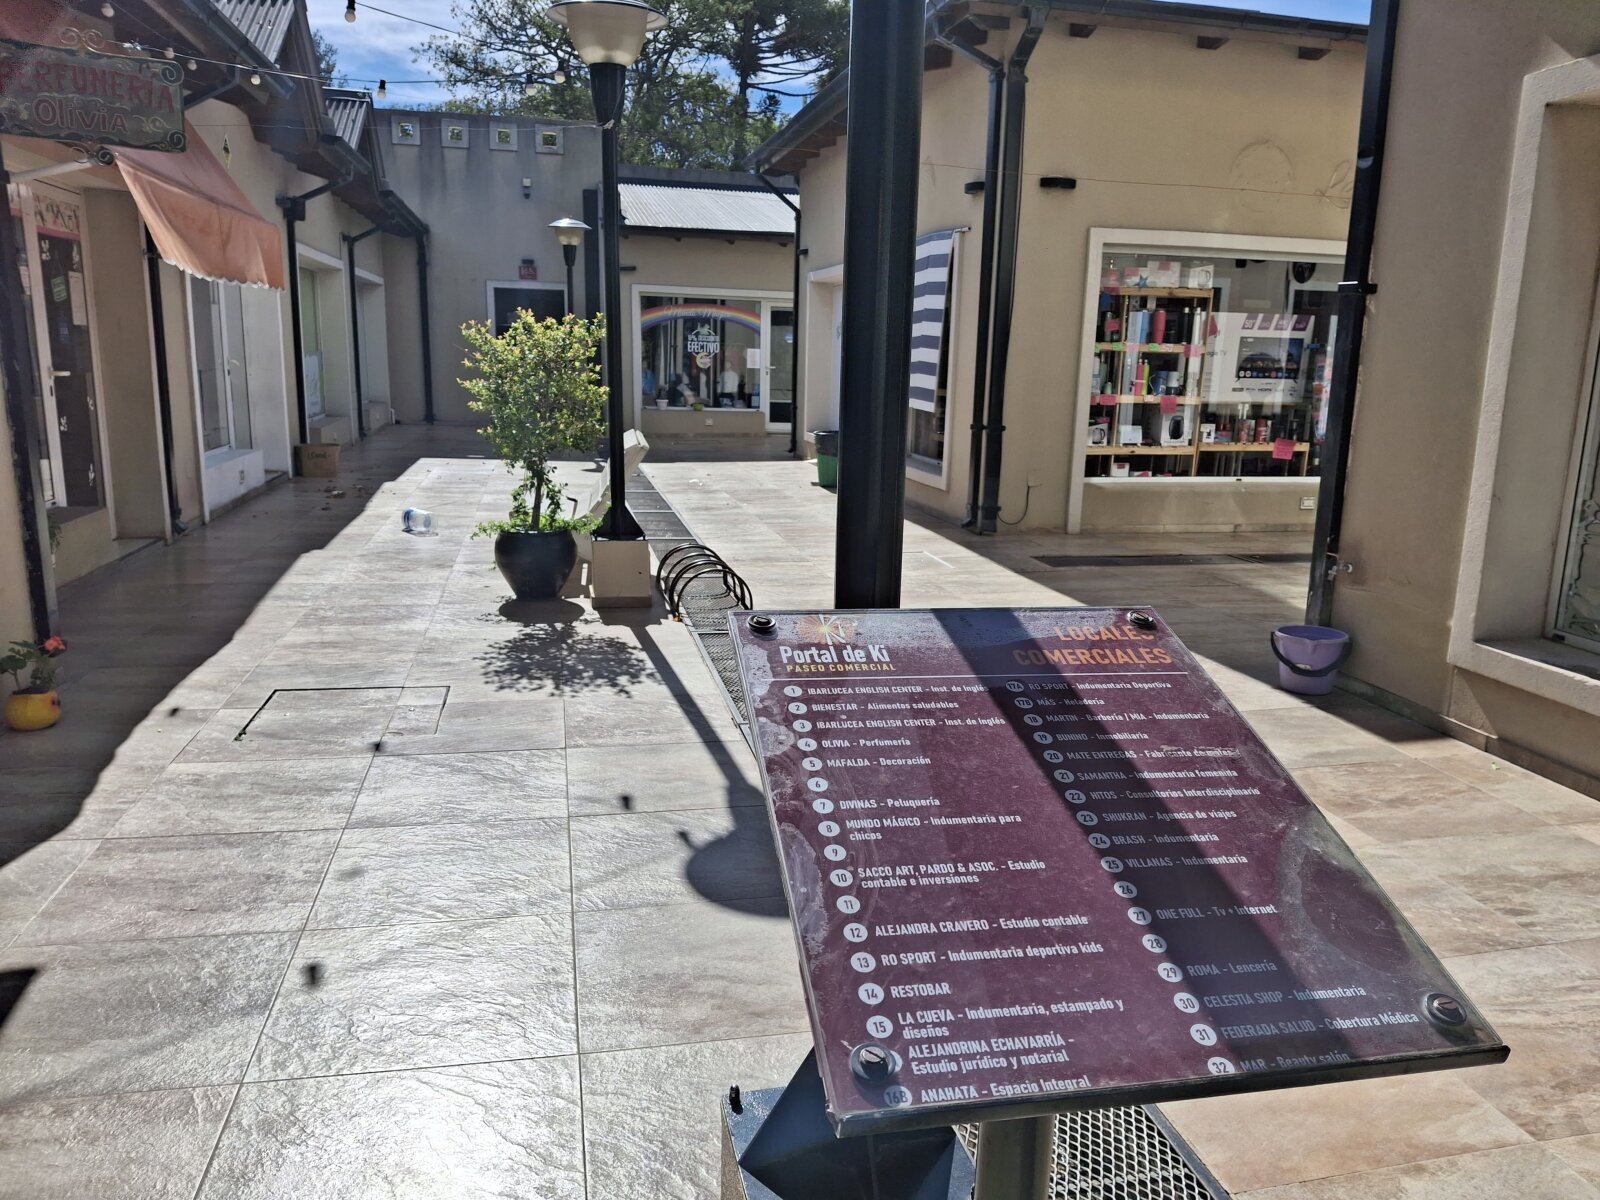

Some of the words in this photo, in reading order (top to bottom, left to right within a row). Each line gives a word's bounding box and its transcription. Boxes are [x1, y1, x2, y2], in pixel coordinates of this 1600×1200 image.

[687, 341, 720, 353] EFECTIVO
[779, 644, 839, 664] Portal
[842, 644, 867, 663] de
[867, 644, 891, 662] Ki
[1012, 648, 1173, 666] COMERCIALES
[786, 664, 825, 673] PASEO
[829, 663, 897, 672] COMERCIAL
[807, 687, 854, 695] IBARLUCEA
[855, 686, 890, 694] ENGLISH
[892, 685, 923, 693] CENTER
[963, 683, 989, 693] Inglés
[1076, 681, 1132, 690] Indumentaria
[1133, 681, 1172, 690] Deportiva
[812, 703, 858, 711] BIENESTAR
[867, 702, 911, 710] Alimentos
[912, 701, 959, 709] saludables
[816, 721, 865, 729] IBARLUCEA
[866, 720, 903, 728] ENGLISH
[904, 718, 936, 727] CENTER
[944, 718, 964, 726] Inst.
[978, 716, 1006, 727] Inglés
[1046, 714, 1079, 722] MARTIN
[1086, 712, 1124, 721] Barbería
[1130, 712, 1147, 721] MIA
[1153, 711, 1210, 720] Indumentaria
[821, 739, 851, 748] OLIVIA
[859, 737, 911, 747] Perfumería
[1096, 731, 1149, 740] Inmobiliaria
[826, 758, 871, 768] MAFALDA
[879, 755, 931, 766] Decoración
[1047, 752, 1060, 760] 20
[1066, 751, 1091, 760] MATE
[1091, 750, 1137, 759] ENTREGAS
[1144, 749, 1192, 758] Fabricante
[1059, 772, 1070, 780] 21
[1076, 771, 1127, 780] SAMANTHA
[1135, 769, 1196, 779] Indumentaria
[1195, 769, 1239, 778] femenina
[1069, 792, 1082, 801] 22
[1090, 791, 1117, 800] HITOS
[1125, 788, 1184, 799] Consultorios
[1183, 787, 1261, 797] Interdisciplinario
[839, 799, 877, 810] DIVINAS
[887, 796, 941, 808] Peluquería
[846, 818, 881, 829] MUNDO
[883, 815, 921, 828] MÁGICO
[930, 814, 997, 826] Indumentaria
[998, 815, 1022, 825] para
[1081, 814, 1094, 823] 23
[1102, 812, 1147, 822] SHUKRAN
[1157, 810, 1195, 821] Agencia
[1195, 810, 1208, 819] de
[1208, 809, 1237, 820] viajes
[849, 832, 882, 841] chicos
[1092, 836, 1107, 845] 24
[1111, 835, 1147, 845] BRASH
[1154, 832, 1220, 843] Indumentaria
[1106, 860, 1119, 870] 25
[1125, 857, 1174, 869] VILLANAS
[1181, 854, 1249, 866] Indumentaria
[836, 873, 847, 883] 10
[857, 866, 892, 878] SACCO
[895, 865, 919, 877] ART,
[920, 863, 955, 875] PARDO
[957, 862, 967, 873] &
[968, 861, 999, 873] ASOC.
[1007, 859, 1046, 871] Estudio
[861, 876, 908, 889] contable
[910, 878, 917, 886] e
[918, 874, 980, 886] inversiones
[1119, 884, 1133, 895] 26
[843, 899, 854, 910] 11
[1132, 911, 1147, 922] 27
[1155, 908, 1179, 920] ONE
[1180, 906, 1204, 919] FULL
[1212, 906, 1227, 917] Tv
[1235, 903, 1278, 916] Internet
[849, 927, 863, 939] 12
[875, 922, 938, 937] ALEJANDRA
[940, 919, 989, 933] CRAVERO
[999, 917, 1040, 930] Estudio
[1042, 914, 1089, 927] contable
[1147, 938, 1161, 949] 28
[856, 957, 870, 969] 13
[880, 954, 898, 967] RO
[901, 951, 937, 965] SPORT
[947, 946, 1025, 962] Indumentaria
[1026, 944, 1079, 959] deportiva
[1078, 941, 1104, 954] kids
[1162, 967, 1177, 979] 29
[1186, 964, 1221, 977] ROMA
[1228, 960, 1278, 974] Lencería
[864, 988, 879, 1000] 14
[890, 982, 951, 999] RESTOBAR
[1179, 998, 1196, 1010] 30
[1203, 994, 1253, 1008] CELESTIA
[1253, 991, 1283, 1004] SHOP
[1293, 985, 1367, 1001] Indumentaria
[872, 1021, 887, 1034] 15
[897, 1012, 915, 1025] LA
[917, 1009, 955, 1024] CUEVA
[965, 1003, 1050, 1020] Indumentaria,
[1051, 997, 1114, 1015] estampado
[1115, 999, 1124, 1012] y
[902, 1024, 950, 1040] diseños
[1195, 1029, 1211, 1041] 31
[1220, 1023, 1280, 1039] FEDERADA
[1278, 1019, 1317, 1034] SALUD
[1324, 1015, 1381, 1030] Cobertura
[1378, 1011, 1420, 1026] Médica
[908, 1040, 990, 1059] ALEJANDRINA
[990, 1031, 1066, 1052] ECHAVARRÍA
[911, 1058, 958, 1075] Estudio
[960, 1054, 1007, 1074] jurídico
[1009, 1057, 1018, 1070] y
[1020, 1049, 1070, 1066] notarial
[1211, 1062, 1230, 1074] 32
[1239, 1058, 1268, 1073] MAR
[1276, 1054, 1317, 1069] Beauty
[1320, 1050, 1350, 1063] salón
[886, 1090, 908, 1104] 16B
[921, 1085, 979, 1103] ANAHATA
[990, 1080, 1039, 1097] Espacio
[1040, 1074, 1091, 1091] Integral
